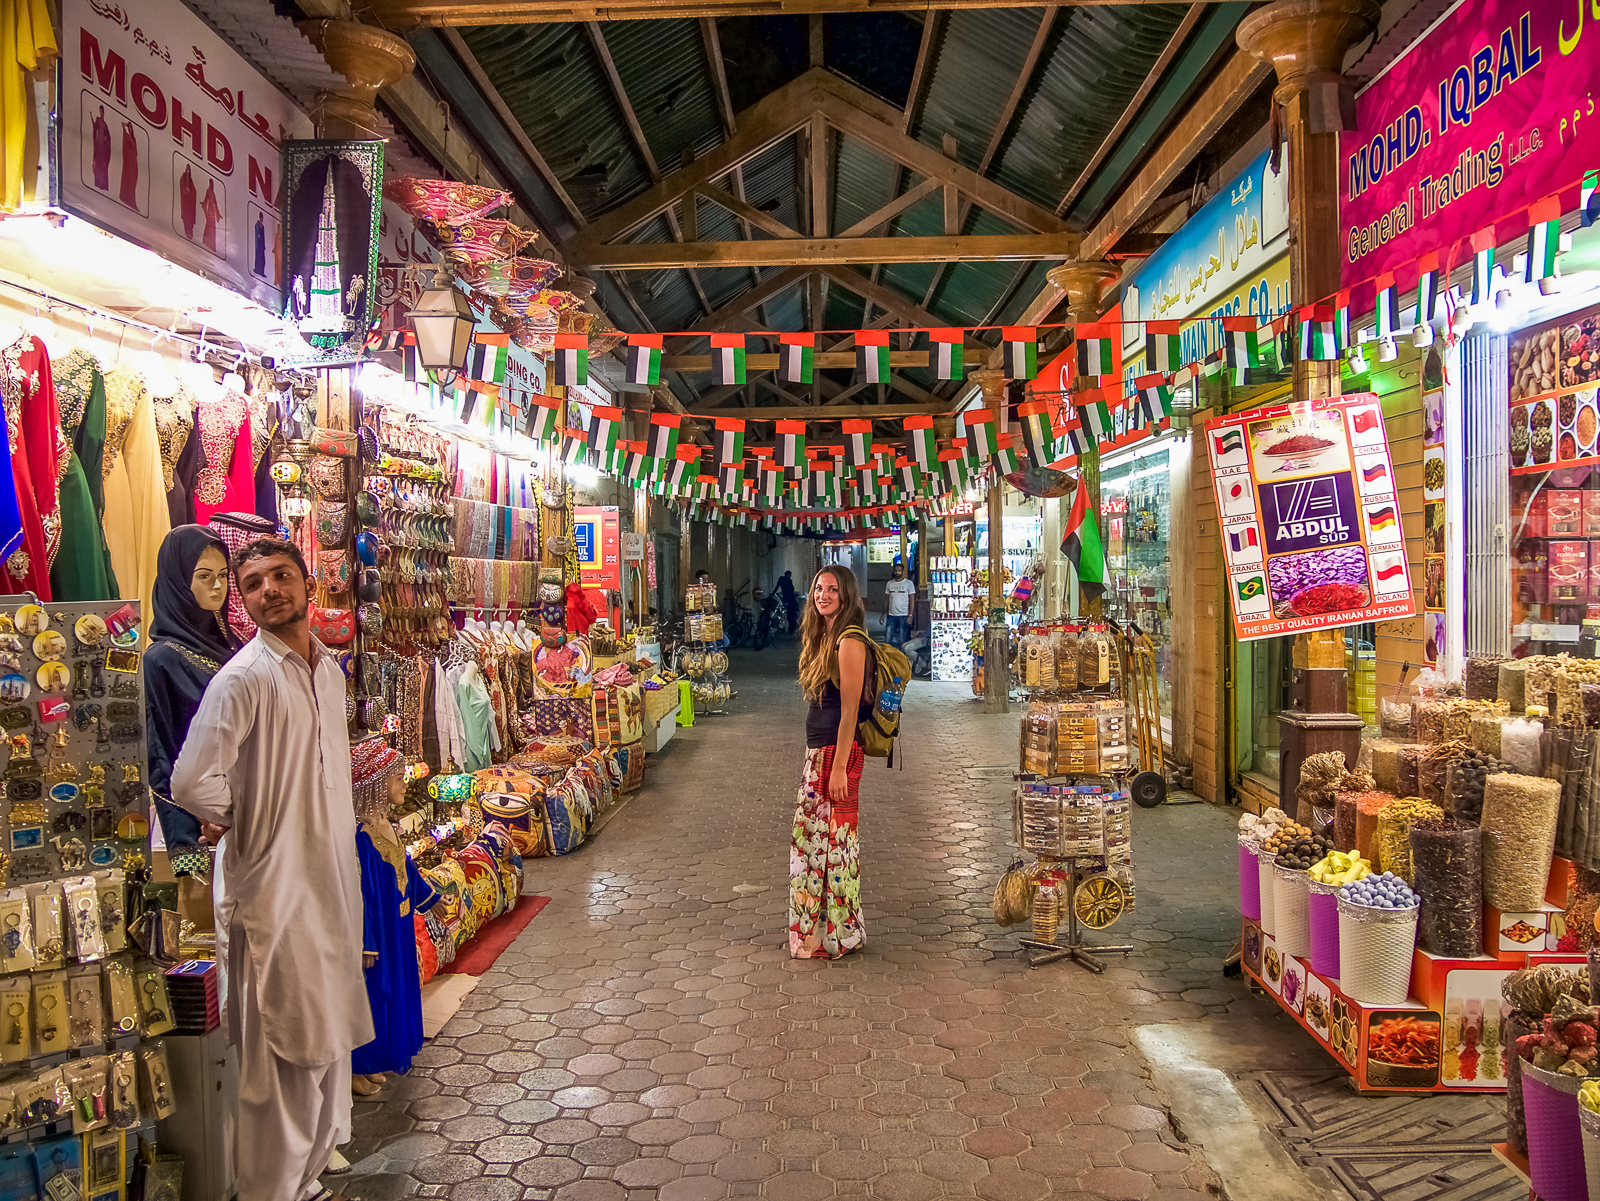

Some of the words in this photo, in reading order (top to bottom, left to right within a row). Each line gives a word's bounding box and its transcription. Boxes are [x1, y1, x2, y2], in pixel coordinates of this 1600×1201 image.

[1349, 104, 1431, 202] MOHD.
[1438, 11, 1542, 137] IQBAL
[80, 26, 234, 176] MOHD
[248, 153, 282, 214] N
[1231, 175, 1253, 206] شركة
[1348, 189, 1415, 263] General
[1419, 132, 1504, 219] Trading
[1508, 128, 1544, 166] L.L.C.
[1230, 206, 1258, 271] هلال
[1184, 226, 1226, 304] الحرمين
[1248, 278, 1273, 326] CO.
[505, 355, 528, 384] DING
[530, 372, 542, 393] CO.
[1358, 446, 1381, 454] CHINA
[1221, 466, 1242, 475] U.A.E
[1364, 495, 1391, 504] RUSSIA
[1227, 514, 1252, 524] JAPAN
[1276, 517, 1349, 541] ABDUL
[1319, 530, 1349, 544] SÜD
[1007, 548, 1033, 558] SILVE
[1369, 543, 1400, 553] GERMANY
[1231, 563, 1262, 573] FRANCE
[1377, 592, 1408, 602] POLAND
[1240, 613, 1267, 622] BRAZIL
[1242, 626, 1260, 635] THE
[1262, 623, 1286, 632] BEST
[1288, 616, 1326, 629] QUALITY
[1327, 611, 1364, 622] IRANIAN
[1365, 604, 1409, 618] SAFFRON
[28, 1084, 54, 1098] DUBAI
